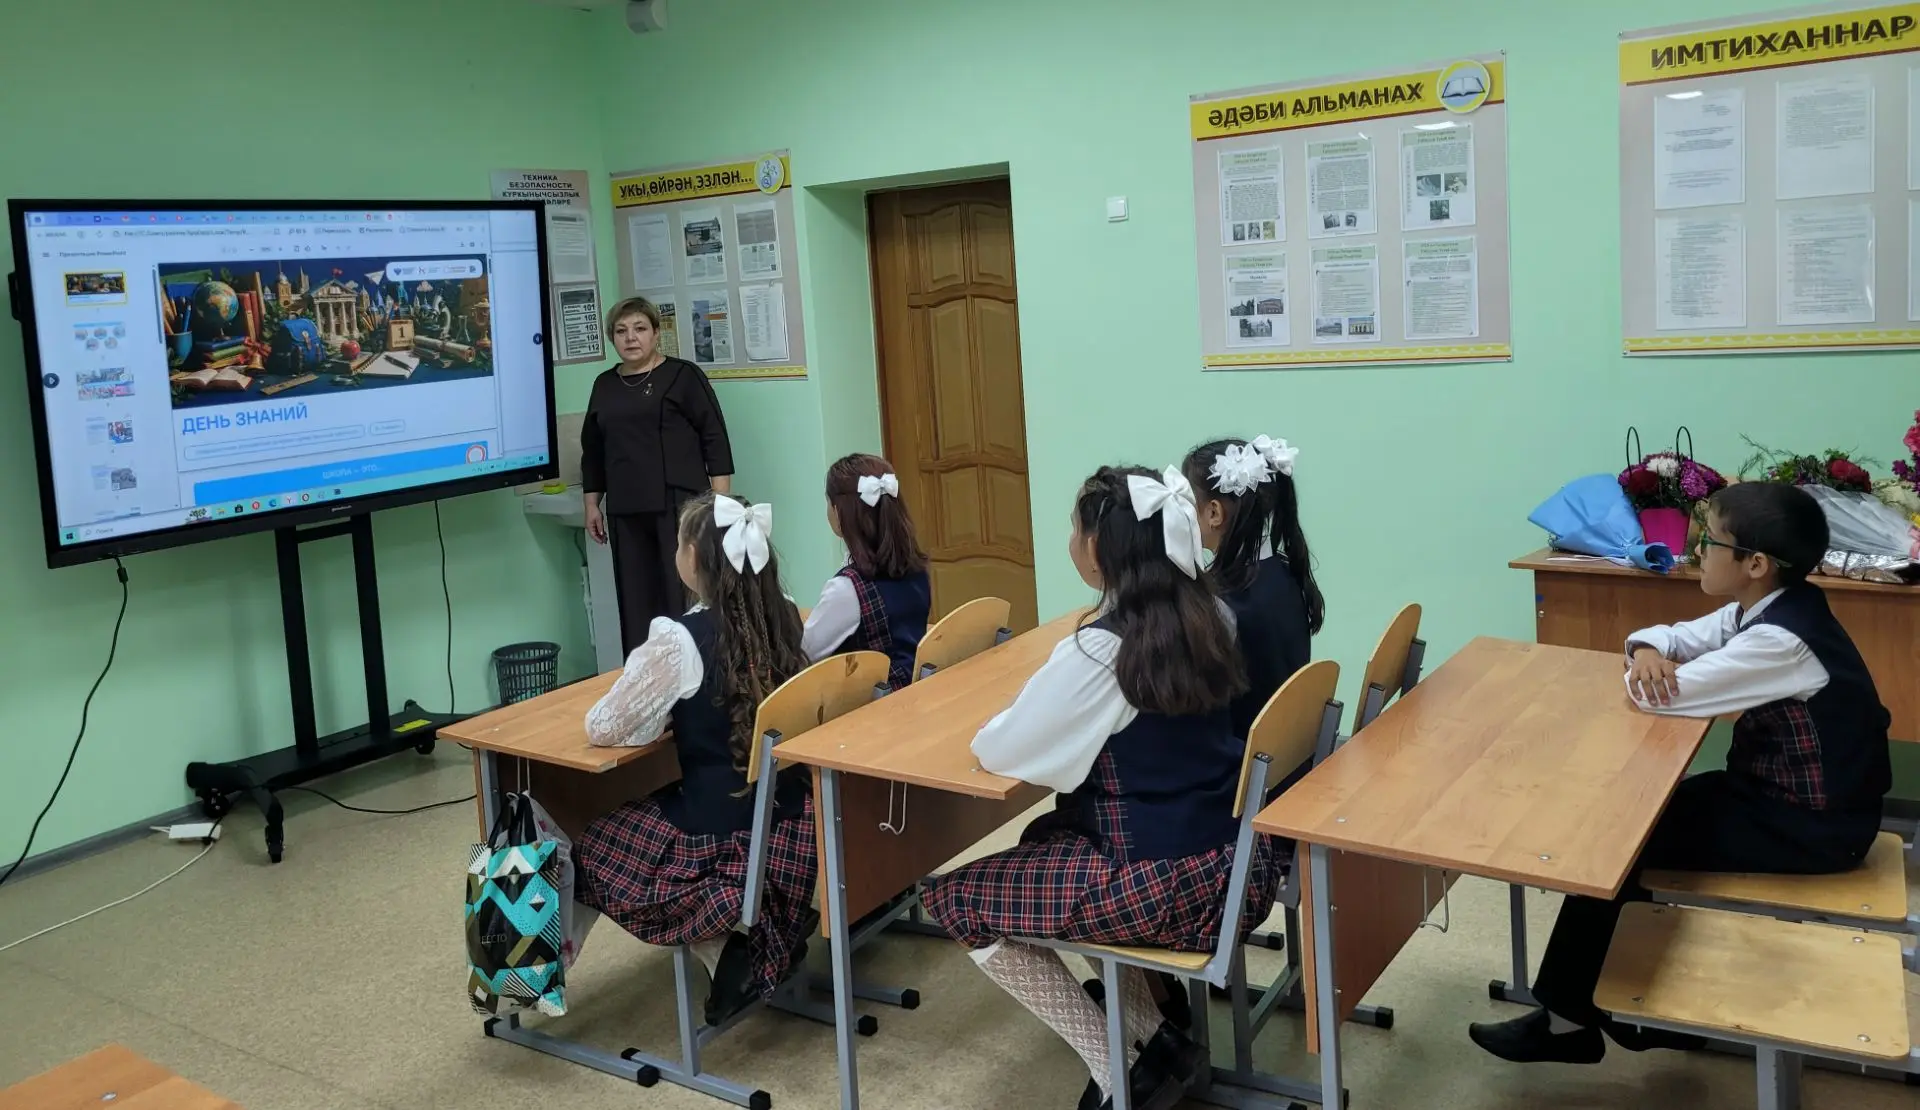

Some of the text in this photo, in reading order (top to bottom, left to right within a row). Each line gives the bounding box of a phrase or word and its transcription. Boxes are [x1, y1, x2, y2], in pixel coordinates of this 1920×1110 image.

[1650, 14, 1914, 68] ИМТИХАННАР
[1208, 81, 1423, 128] ӘДӘБИ АЛЬМАНАХ
[583, 303, 595, 311] 101
[584, 313, 597, 321] 102
[182, 402, 308, 435] ДЕНЬ ЗНАНИЙ
